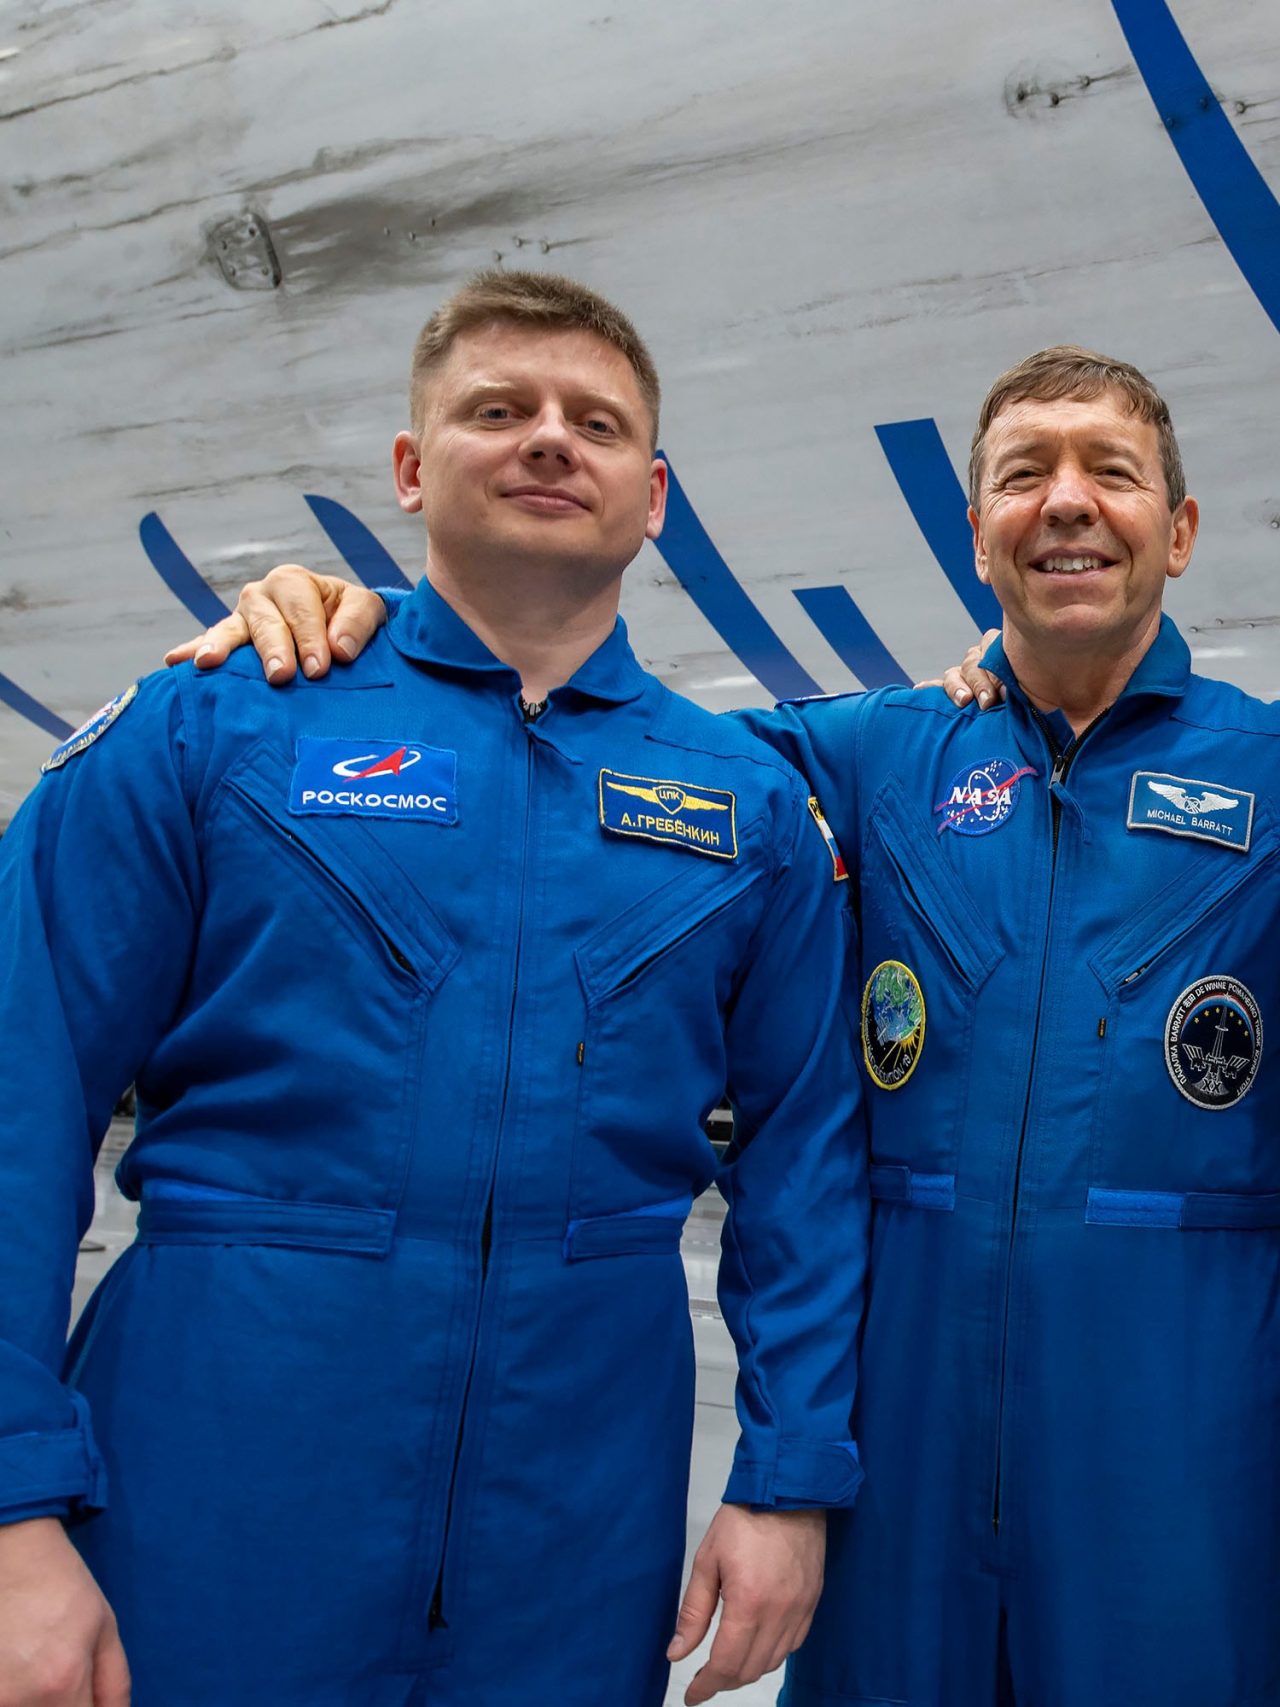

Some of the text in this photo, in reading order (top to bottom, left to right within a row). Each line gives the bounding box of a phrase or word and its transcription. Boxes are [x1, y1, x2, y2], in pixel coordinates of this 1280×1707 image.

[302, 790, 447, 812] РОСКОСМОС
[659, 789, 680, 801] ЦПК
[948, 786, 1012, 805] NASA
[621, 812, 720, 846] А.ГРЕБЁНКИН
[1147, 809, 1233, 836] MICHAEL BARRATT
[1170, 1006, 1186, 1042] BARRATT
